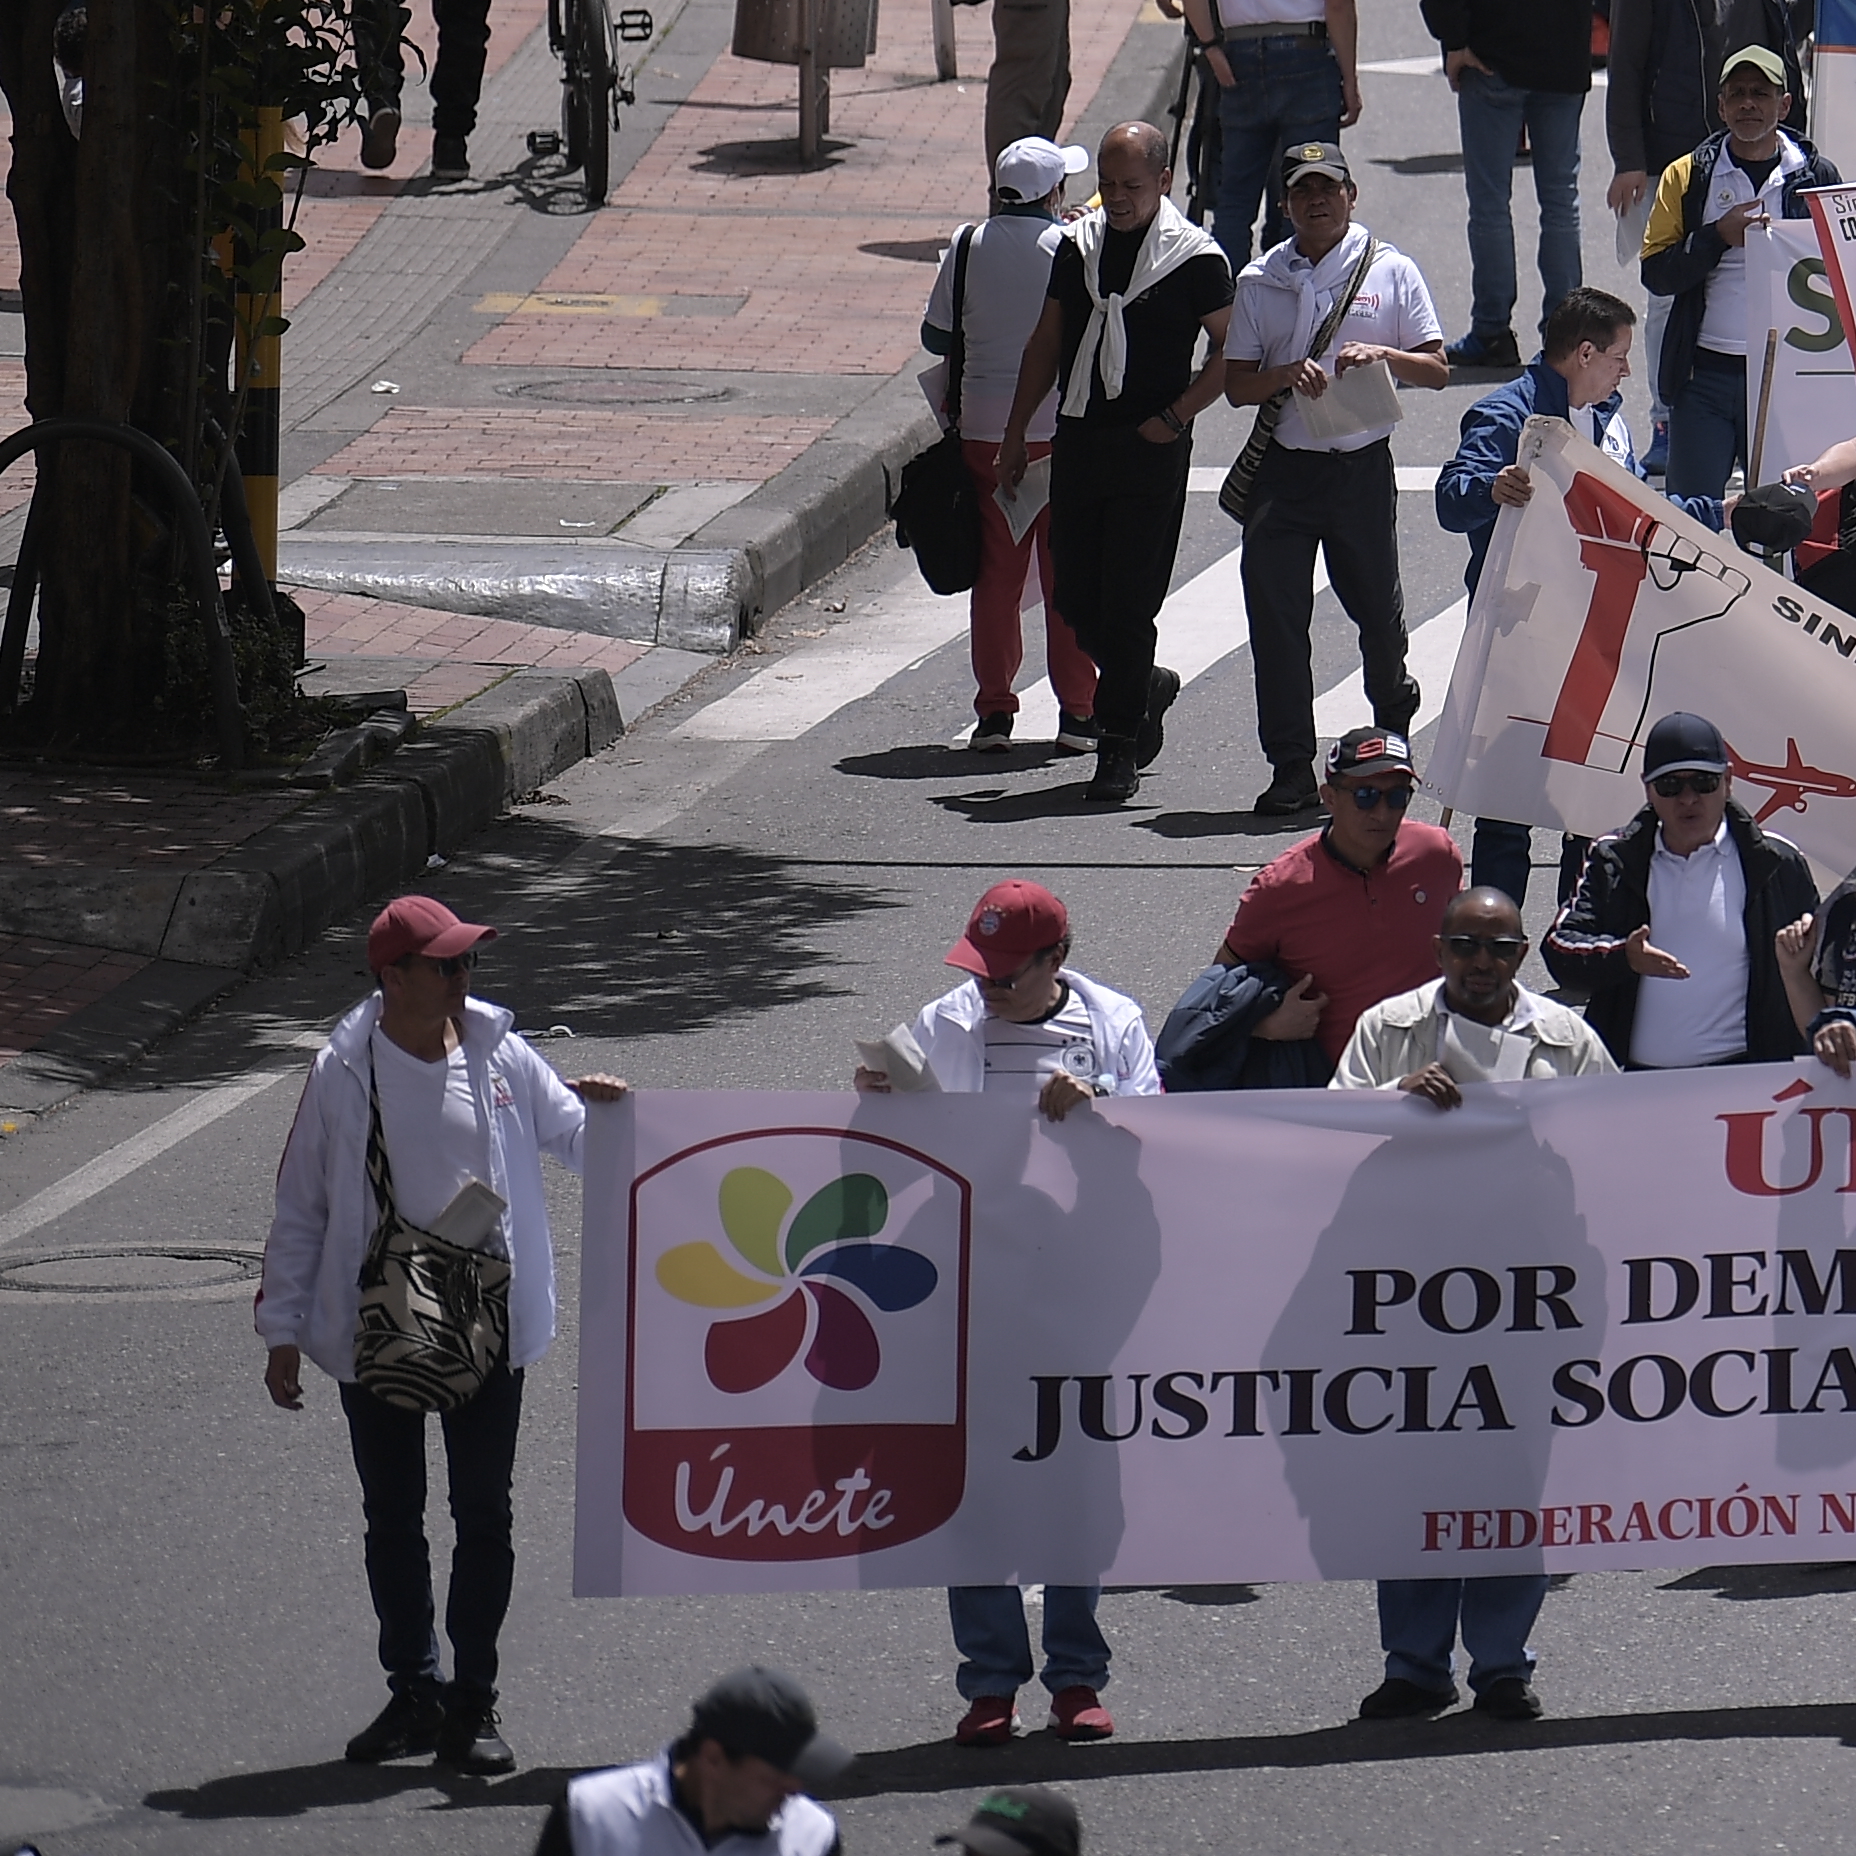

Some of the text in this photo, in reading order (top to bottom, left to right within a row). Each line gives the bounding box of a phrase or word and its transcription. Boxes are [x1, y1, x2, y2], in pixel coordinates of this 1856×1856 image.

[1343, 1263, 1585, 1337] POR
[1012, 1362, 1517, 1462] JUSTICIA
[675, 1442, 896, 1539] Únete
[1422, 1480, 1800, 1555] FEDERACIÓN
